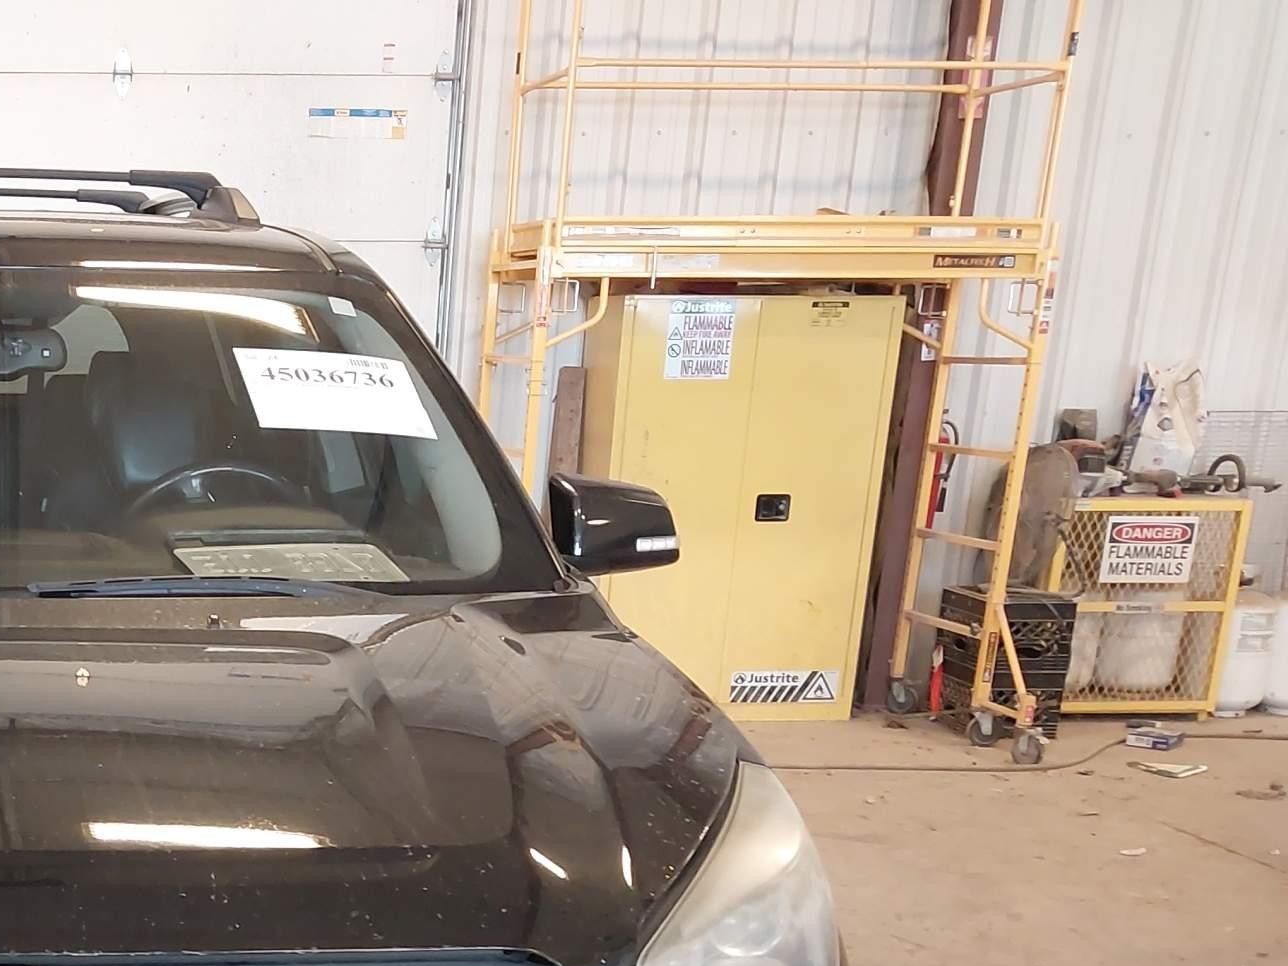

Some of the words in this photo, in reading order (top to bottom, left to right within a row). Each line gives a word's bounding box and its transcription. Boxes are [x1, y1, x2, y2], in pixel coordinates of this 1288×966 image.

[684, 300, 733, 313] Justrite
[683, 315, 733, 330] FLAMMABLE
[682, 340, 730, 355] INFLAMABLE
[681, 360, 729, 375] INFLAMMABLE
[261, 366, 395, 388] 45036736
[1121, 527, 1182, 539] DANGER
[1108, 546, 1190, 559] FLAMMABLE
[1107, 562, 1184, 576] MATERIALS
[747, 673, 800, 684] Justrite
